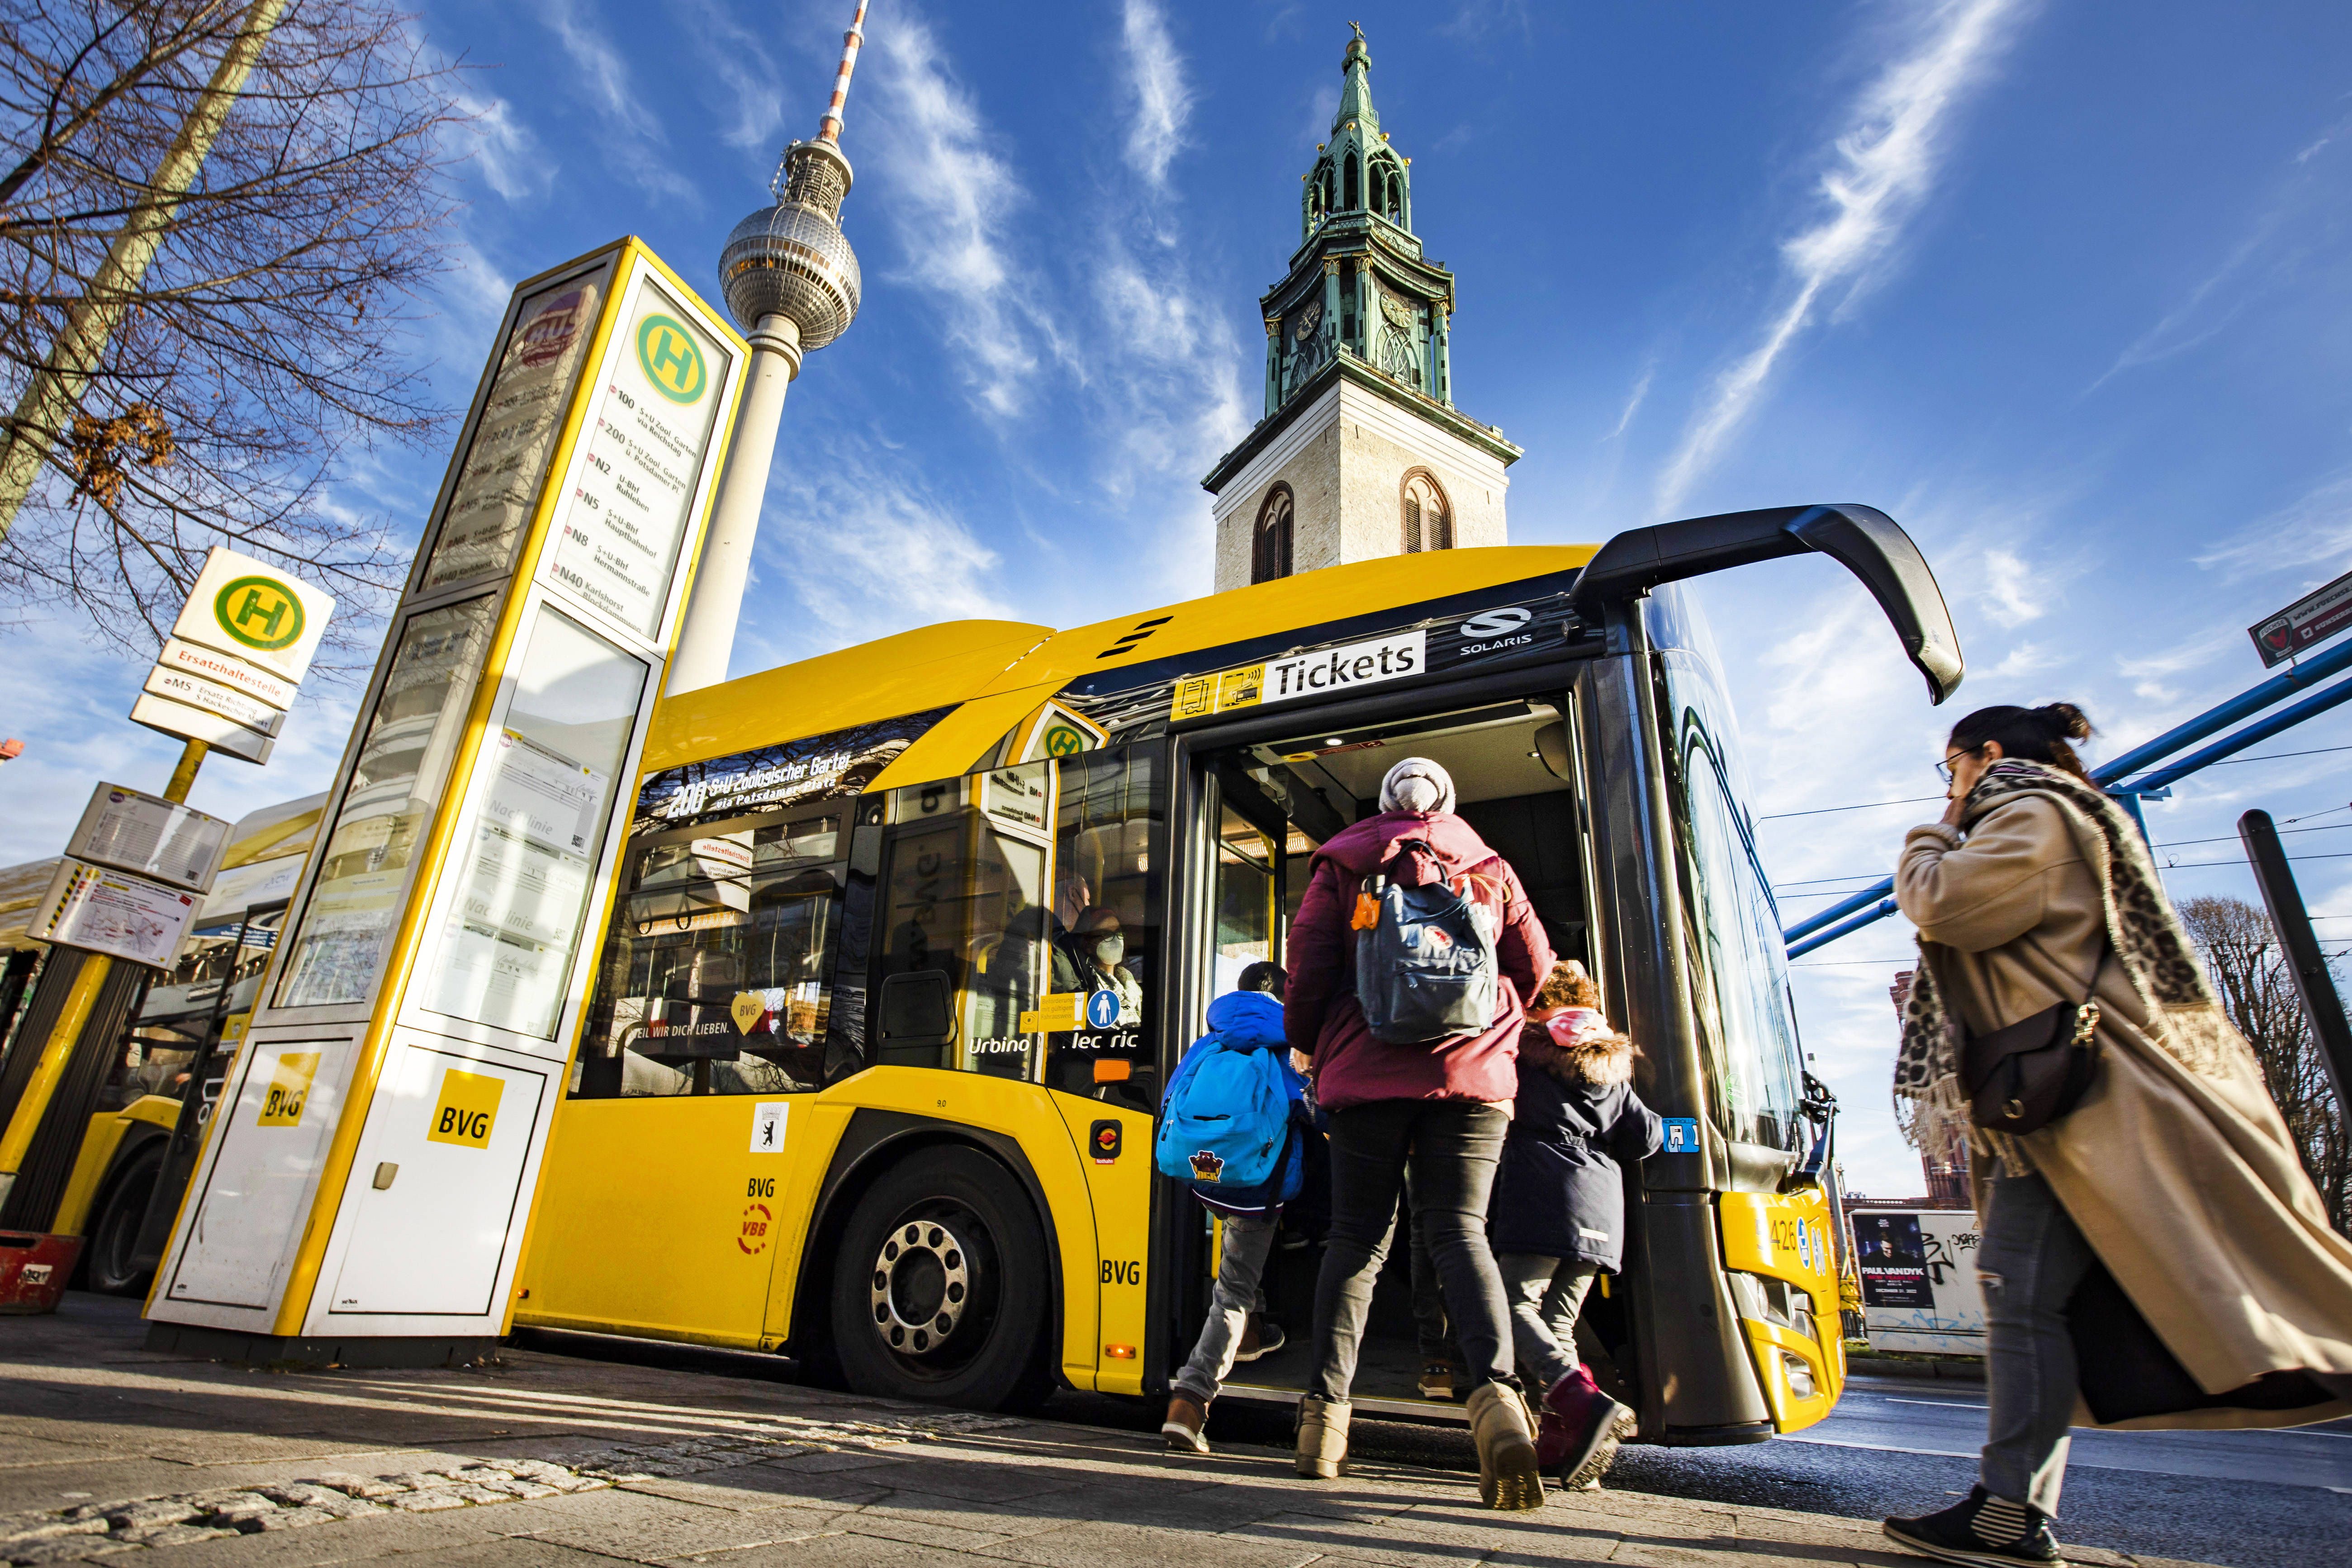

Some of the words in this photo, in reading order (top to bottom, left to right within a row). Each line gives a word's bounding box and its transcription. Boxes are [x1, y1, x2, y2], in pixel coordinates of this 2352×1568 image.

[653, 329, 693, 390] H
[618, 390, 635, 409] 100
[605, 423, 626, 444] 200
[637, 417, 648, 429] via
[649, 426, 682, 458] Reichstag
[640, 407, 655, 423] S+U
[655, 421, 673, 439] Zool.
[674, 436, 697, 459] Garten
[596, 457, 611, 476] N2
[626, 448, 632, 459] ü.
[634, 455, 671, 488] Potsdamer
[628, 440, 644, 455] S+U
[645, 453, 661, 470] Zool.
[663, 468, 687, 489] Garten
[619, 474, 640, 494] U-Bhf
[583, 492, 600, 510] N5
[616, 483, 650, 513] Ruhleben
[607, 508, 639, 535] S+U-Bhf
[571, 529, 589, 547] N8
[605, 518, 657, 559] Hauptbahnhof
[597, 545, 629, 571] S+U-Bhf
[560, 566, 583, 588] N40
[594, 554, 650, 597] Hermannstraße
[585, 582, 624, 612] Karlshorst
[2293, 585, 2352, 621] WWW.FUECHSE.
[236, 588, 288, 638] H
[2261, 619, 2286, 636] FÜCHSE
[1460, 634, 1532, 656] SOLARIS
[179, 650, 280, 697] Ersatzhaltestelle
[1275, 645, 1414, 695] Tickets
[172, 678, 192, 691] M5
[199, 686, 223, 701] Ersatz
[203, 697, 245, 717] Hackescher
[247, 714, 268, 729] Markt
[709, 775, 734, 797] S+U
[733, 763, 809, 792] Zoologischer
[717, 799, 733, 809] via
[736, 786, 800, 806] Potsdamer
[804, 777, 836, 792] Platz
[667, 781, 707, 820] 200
[740, 1004, 756, 1017] BVG
[1042, 997, 1073, 1005] Beförderung
[1051, 1004, 1074, 1013] gültigem
[653, 1026, 669, 1037] WIR
[672, 1024, 692, 1037] DICH
[695, 1022, 730, 1036] LIEBEN.
[968, 1036, 1030, 1054] Urbino
[265, 1090, 303, 1118] BVG
[438, 1106, 489, 1139] BVG
[747, 1178, 775, 1198] BVG
[742, 1221, 768, 1237] VBB
[1101, 1259, 1140, 1286] BVG
